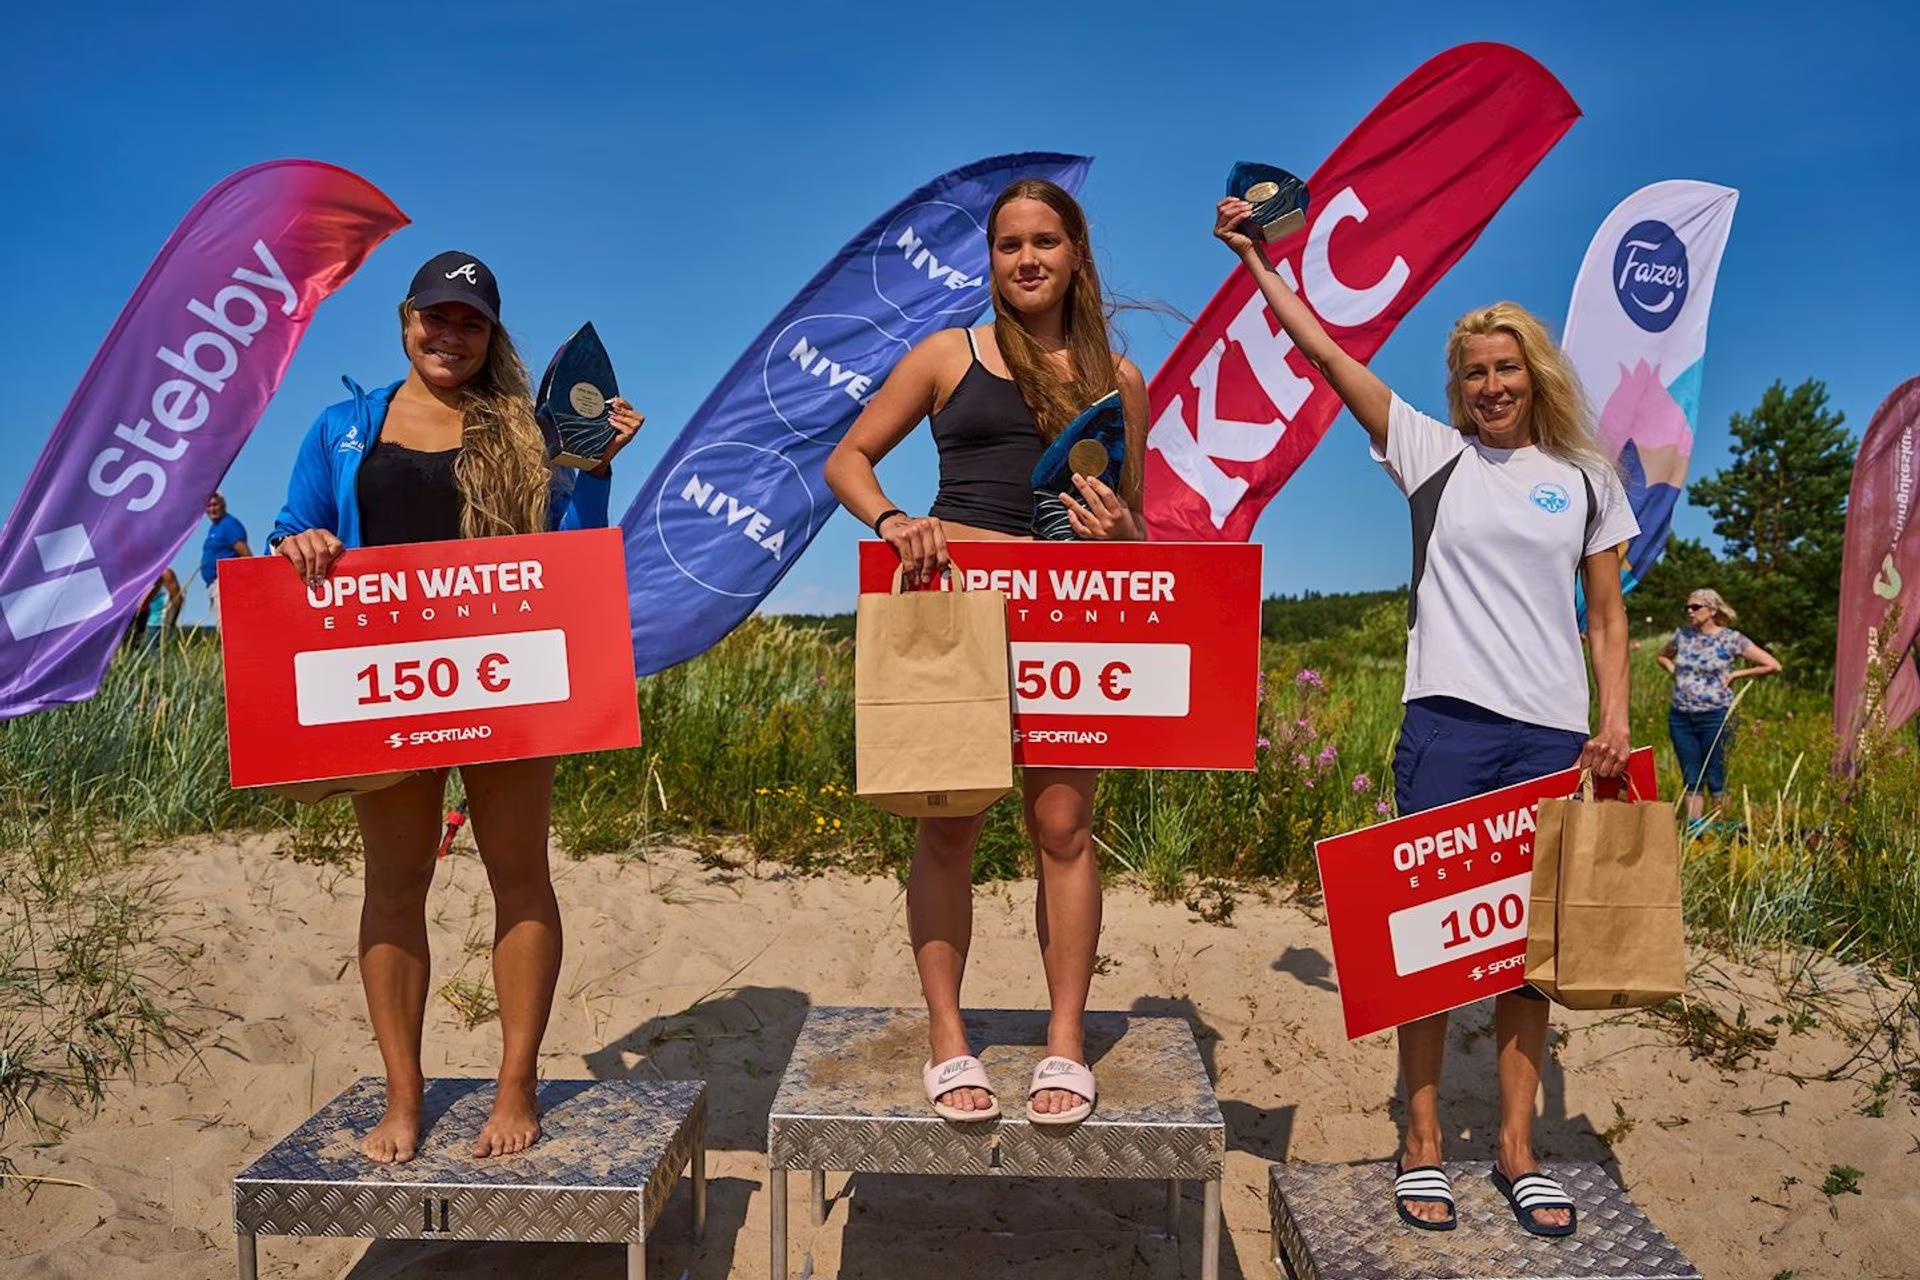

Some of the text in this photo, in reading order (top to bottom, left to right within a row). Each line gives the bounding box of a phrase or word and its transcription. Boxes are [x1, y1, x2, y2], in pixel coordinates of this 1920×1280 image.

[896, 226, 983, 291] NIVEA
[1619, 240, 1685, 289] Fazer
[88, 239, 299, 512] Stebby
[788, 336, 873, 405] NIVE
[1147, 186, 1410, 530] KFC
[681, 474, 788, 561] NIVEA
[307, 560, 544, 608] OPEN WATER
[1049, 570, 1176, 601] WATER
[324, 600, 532, 629] ESTONIA
[1019, 610, 1160, 623] TONIA
[357, 653, 511, 705] 150 €
[1016, 660, 1132, 701] 50 €
[409, 725, 492, 745] SPORTLAND
[1028, 730, 1108, 744] SPORTLAND
[1393, 823, 1478, 871] OPEN
[1409, 843, 1530, 888] ESTON
[1441, 893, 1524, 950] 100
[1488, 953, 1527, 975] SPORT
[943, 1060, 970, 1076] NIKE
[1046, 1060, 1074, 1072] NIKE
